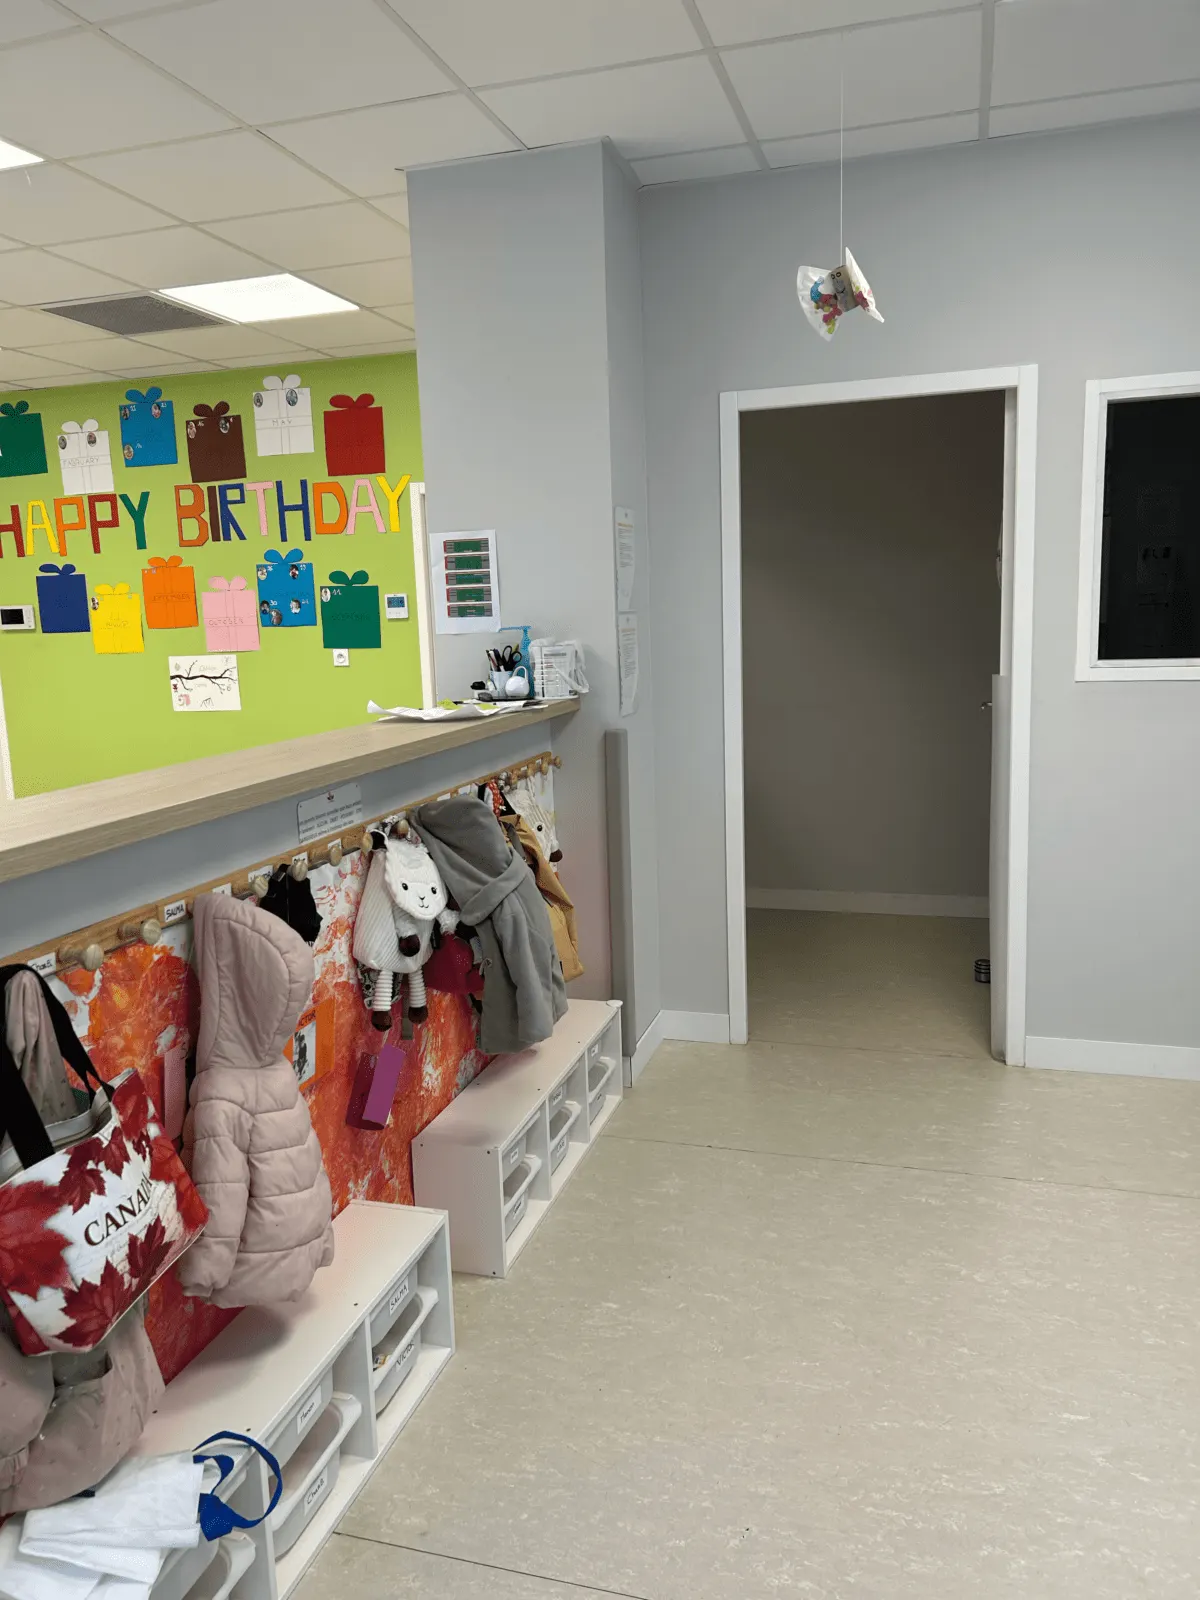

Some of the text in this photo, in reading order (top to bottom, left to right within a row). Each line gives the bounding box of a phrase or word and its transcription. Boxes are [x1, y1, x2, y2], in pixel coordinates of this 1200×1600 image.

[271, 419, 293, 427] MAY
[0, 474, 412, 559] HAPPY BIRTHDAY
[390, 1283, 408, 1311] SALMA
[396, 1341, 415, 1366] VICTOR
